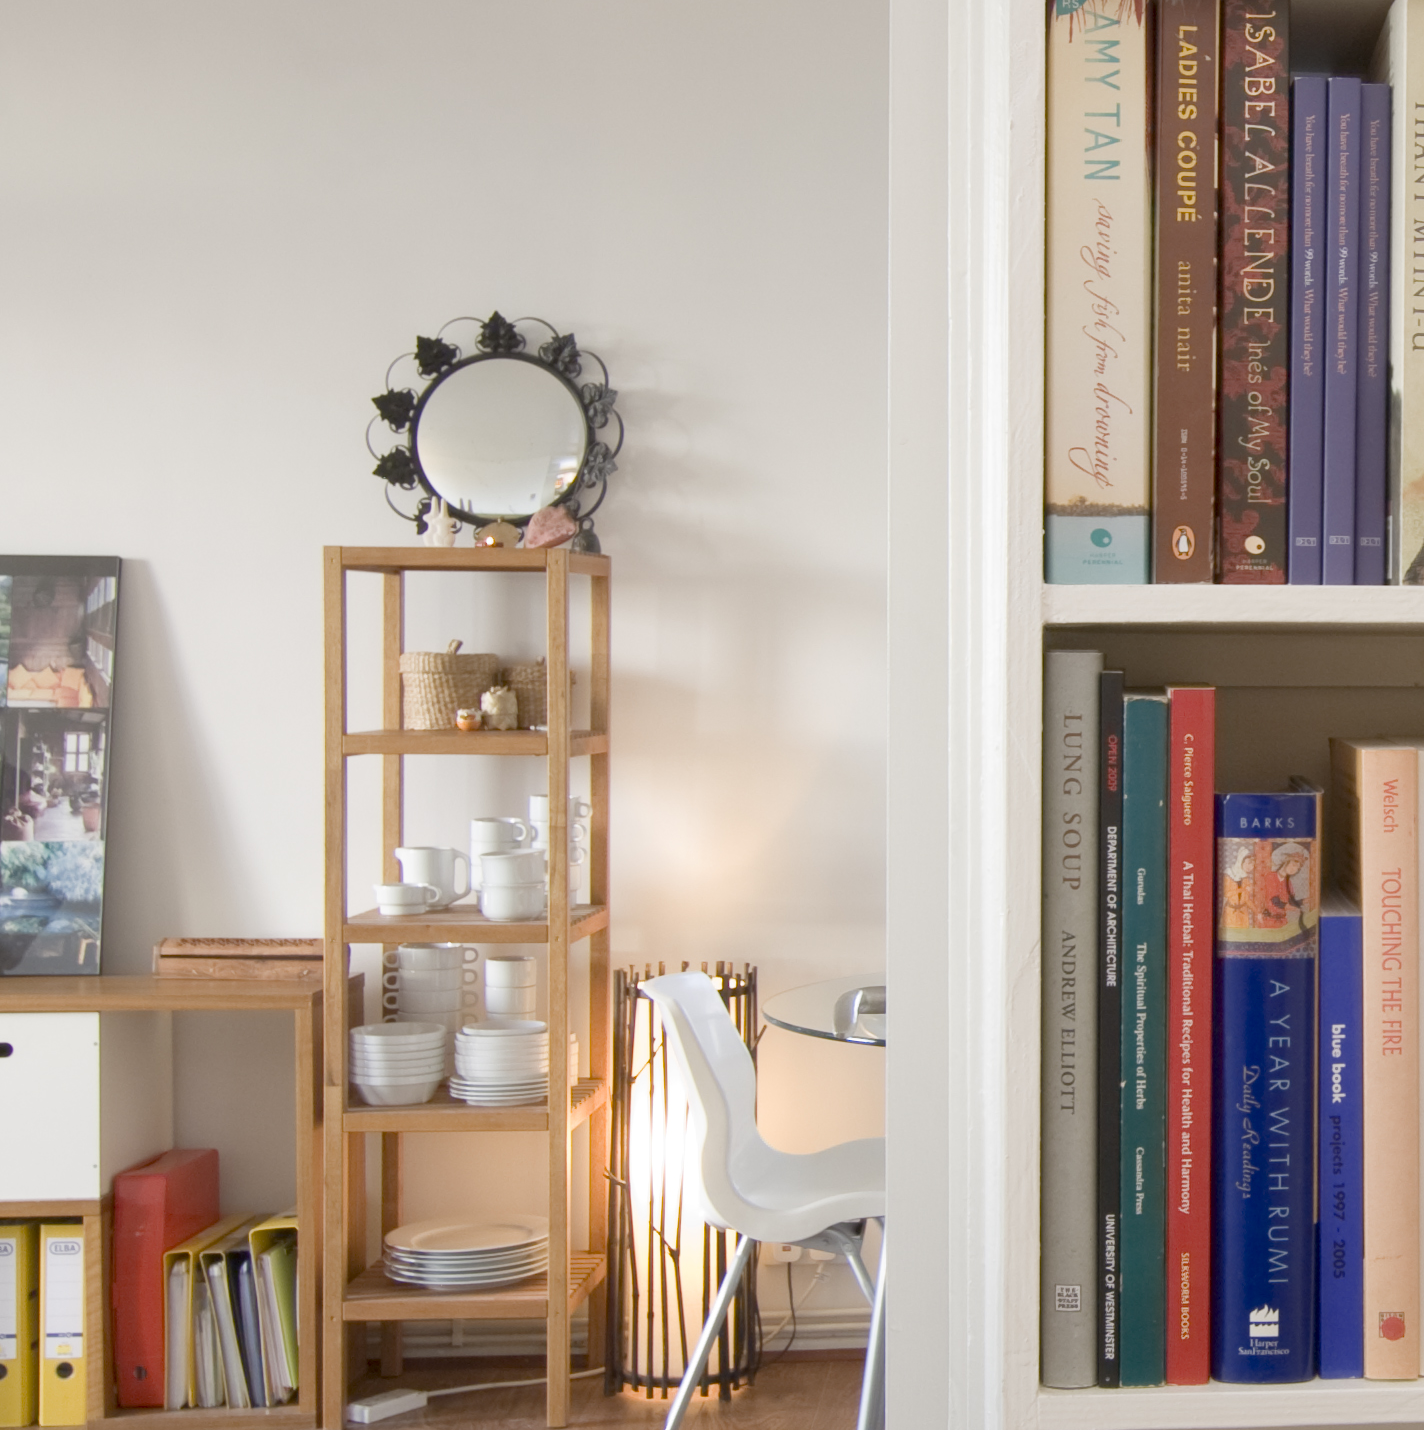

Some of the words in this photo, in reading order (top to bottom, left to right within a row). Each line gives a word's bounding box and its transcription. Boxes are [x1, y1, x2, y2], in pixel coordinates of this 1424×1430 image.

[1084, 10, 1120, 90] AMY
[1178, 26, 1198, 120] LADIES
[1244, 11, 1276, 141] ISABEL
[1084, 103, 1120, 180] TAN
[1177, 131, 1202, 222] COUPÉ
[1240, 151, 1275, 324] ALLENDE
[1178, 260, 1197, 316] anita
[1177, 327, 1196, 372] nair
[1248, 340, 1270, 384] Inés
[1248, 391, 1272, 416] of
[1239, 416, 1270, 451] My
[1247, 457, 1271, 503] Soul
[1240, 817, 1295, 829] BARKS
[1270, 979, 1290, 998] A
[1269, 1015, 1290, 1091] YEAR
[1331, 1024, 1346, 1059] blue
[1331, 1063, 1346, 1104] book
[1269, 1107, 1290, 1191] WITH
[54, 1244, 76, 1252] ELBA
[1267, 1206, 1289, 1284] RUMI
